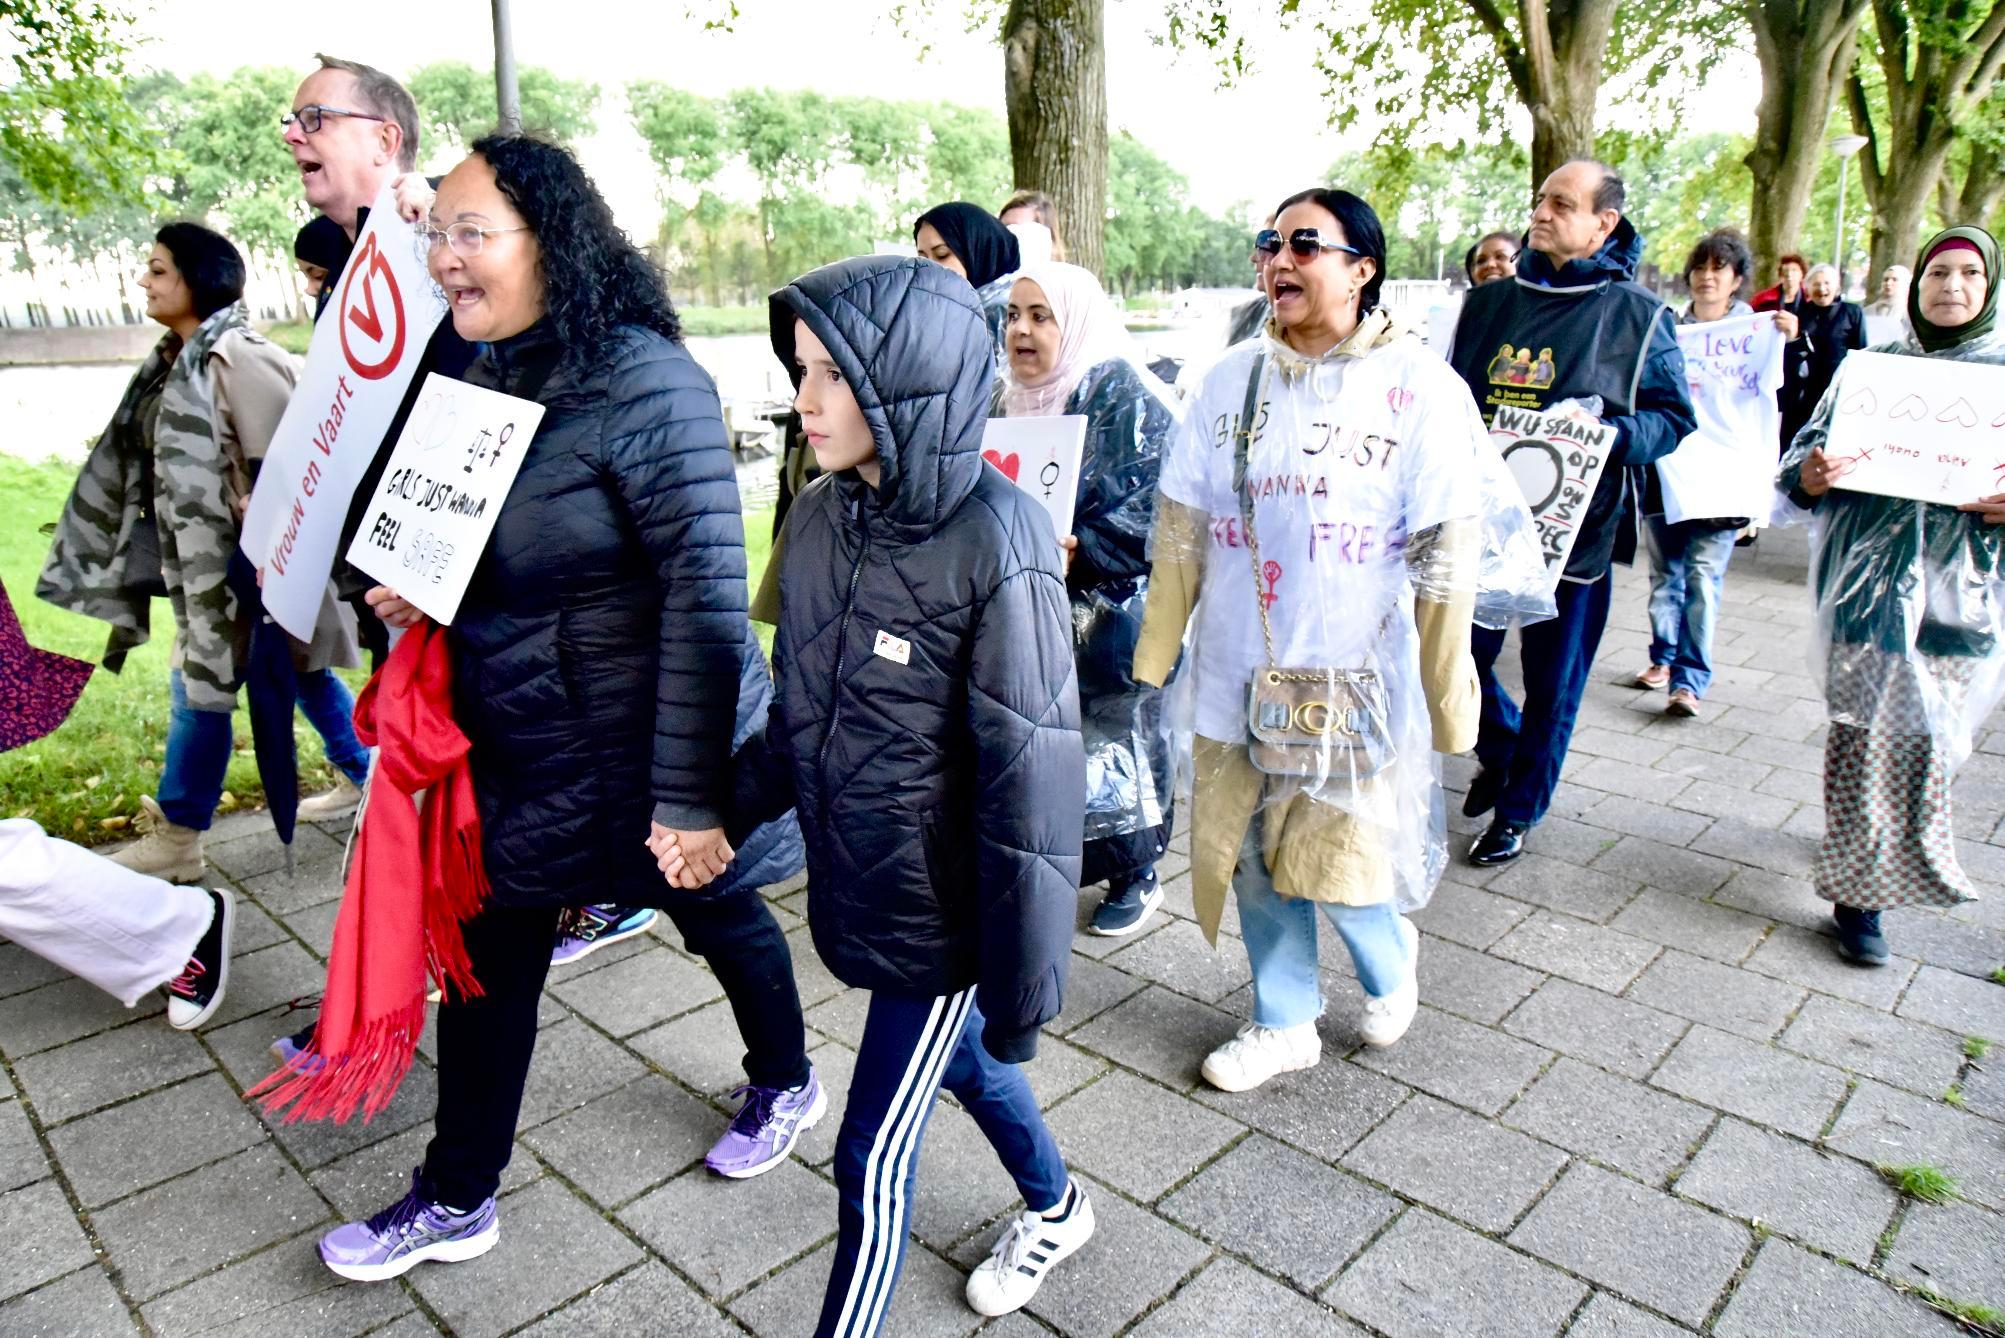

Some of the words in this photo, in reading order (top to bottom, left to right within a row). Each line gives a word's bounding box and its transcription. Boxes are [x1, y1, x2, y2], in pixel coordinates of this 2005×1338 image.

[1303, 422, 1398, 471] JUST
[1543, 416, 1605, 446] STAAN
[270, 497, 305, 577] Vrouw
[302, 460, 322, 498] en
[312, 374, 354, 457] Vaart
[1567, 450, 1600, 480] OP
[387, 468, 422, 500] GIRLS
[416, 478, 453, 513] JUST
[447, 490, 487, 519] WANNA
[1247, 474, 1329, 501] WANNA
[368, 511, 402, 552] FEEL
